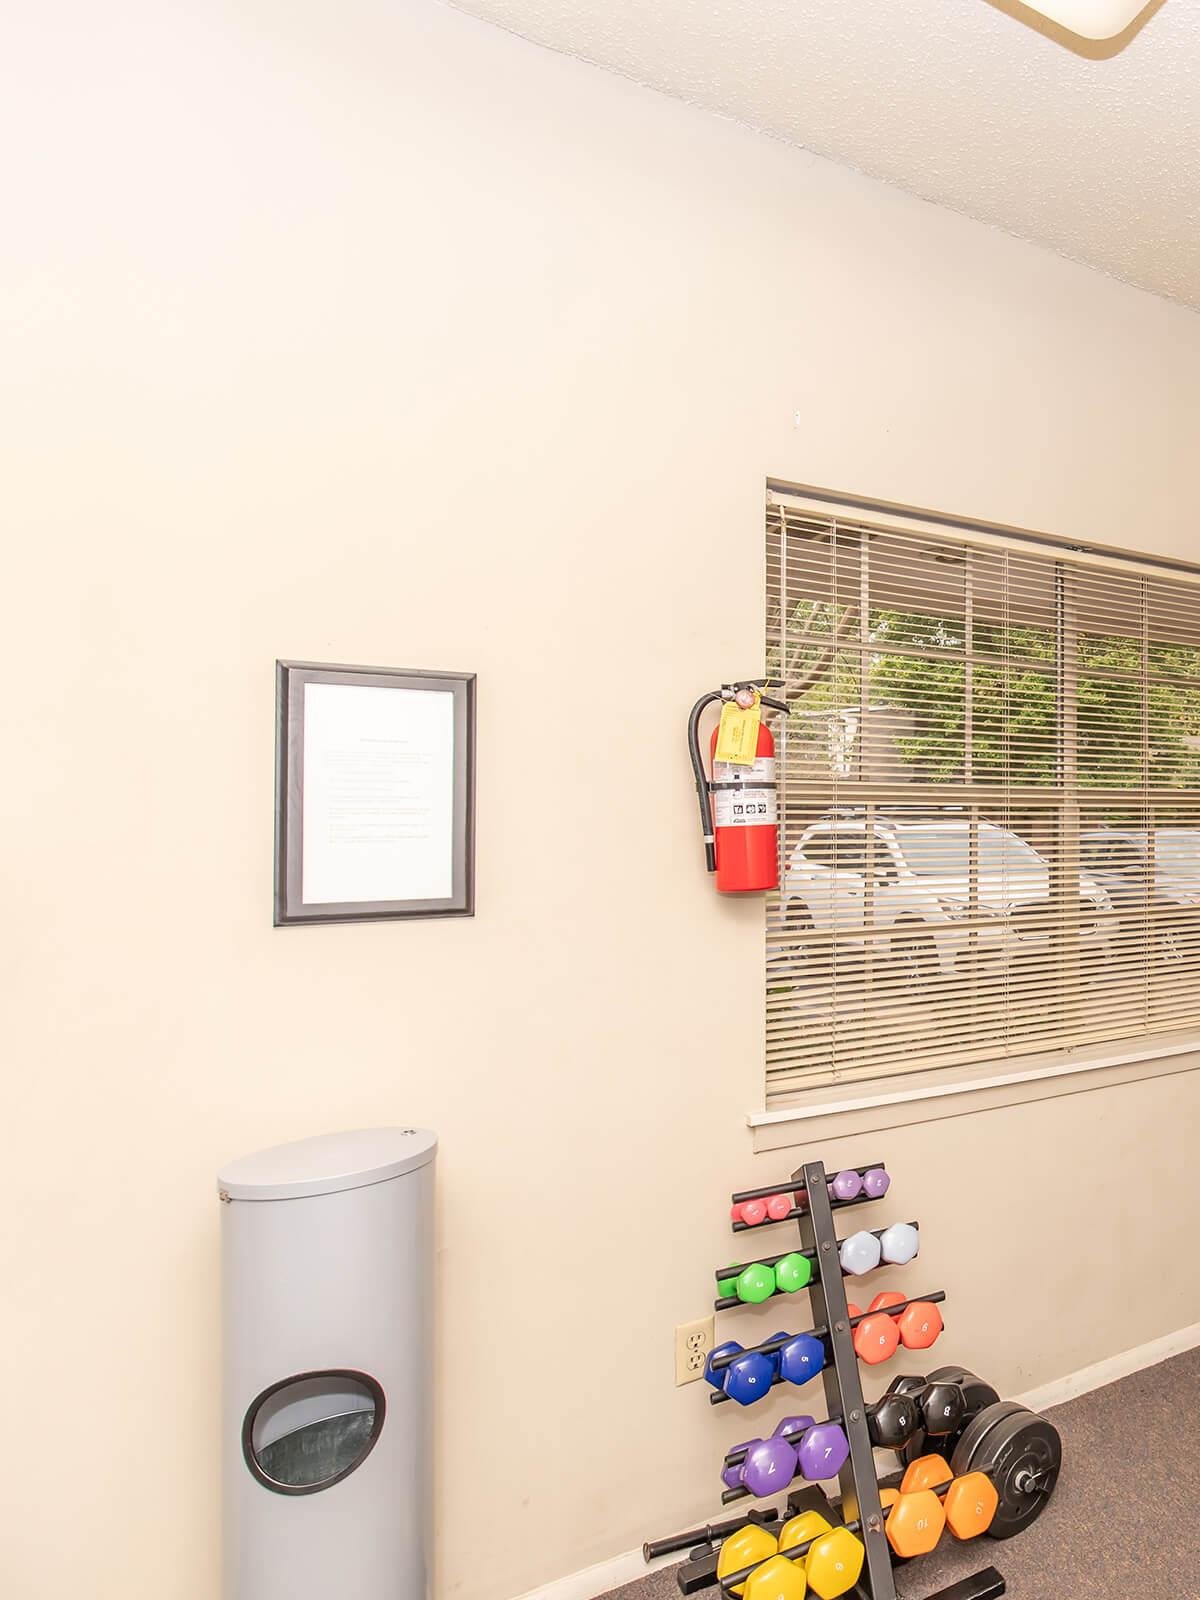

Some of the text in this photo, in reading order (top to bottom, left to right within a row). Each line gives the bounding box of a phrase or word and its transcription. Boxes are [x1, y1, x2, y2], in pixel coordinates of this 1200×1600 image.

[921, 1322, 929, 1333] 6
[879, 1335, 886, 1345] 6
[943, 1405, 951, 1417] 8
[898, 1415, 906, 1427] 8
[823, 1447, 833, 1459] 7
[767, 1461, 776, 1475] 7
